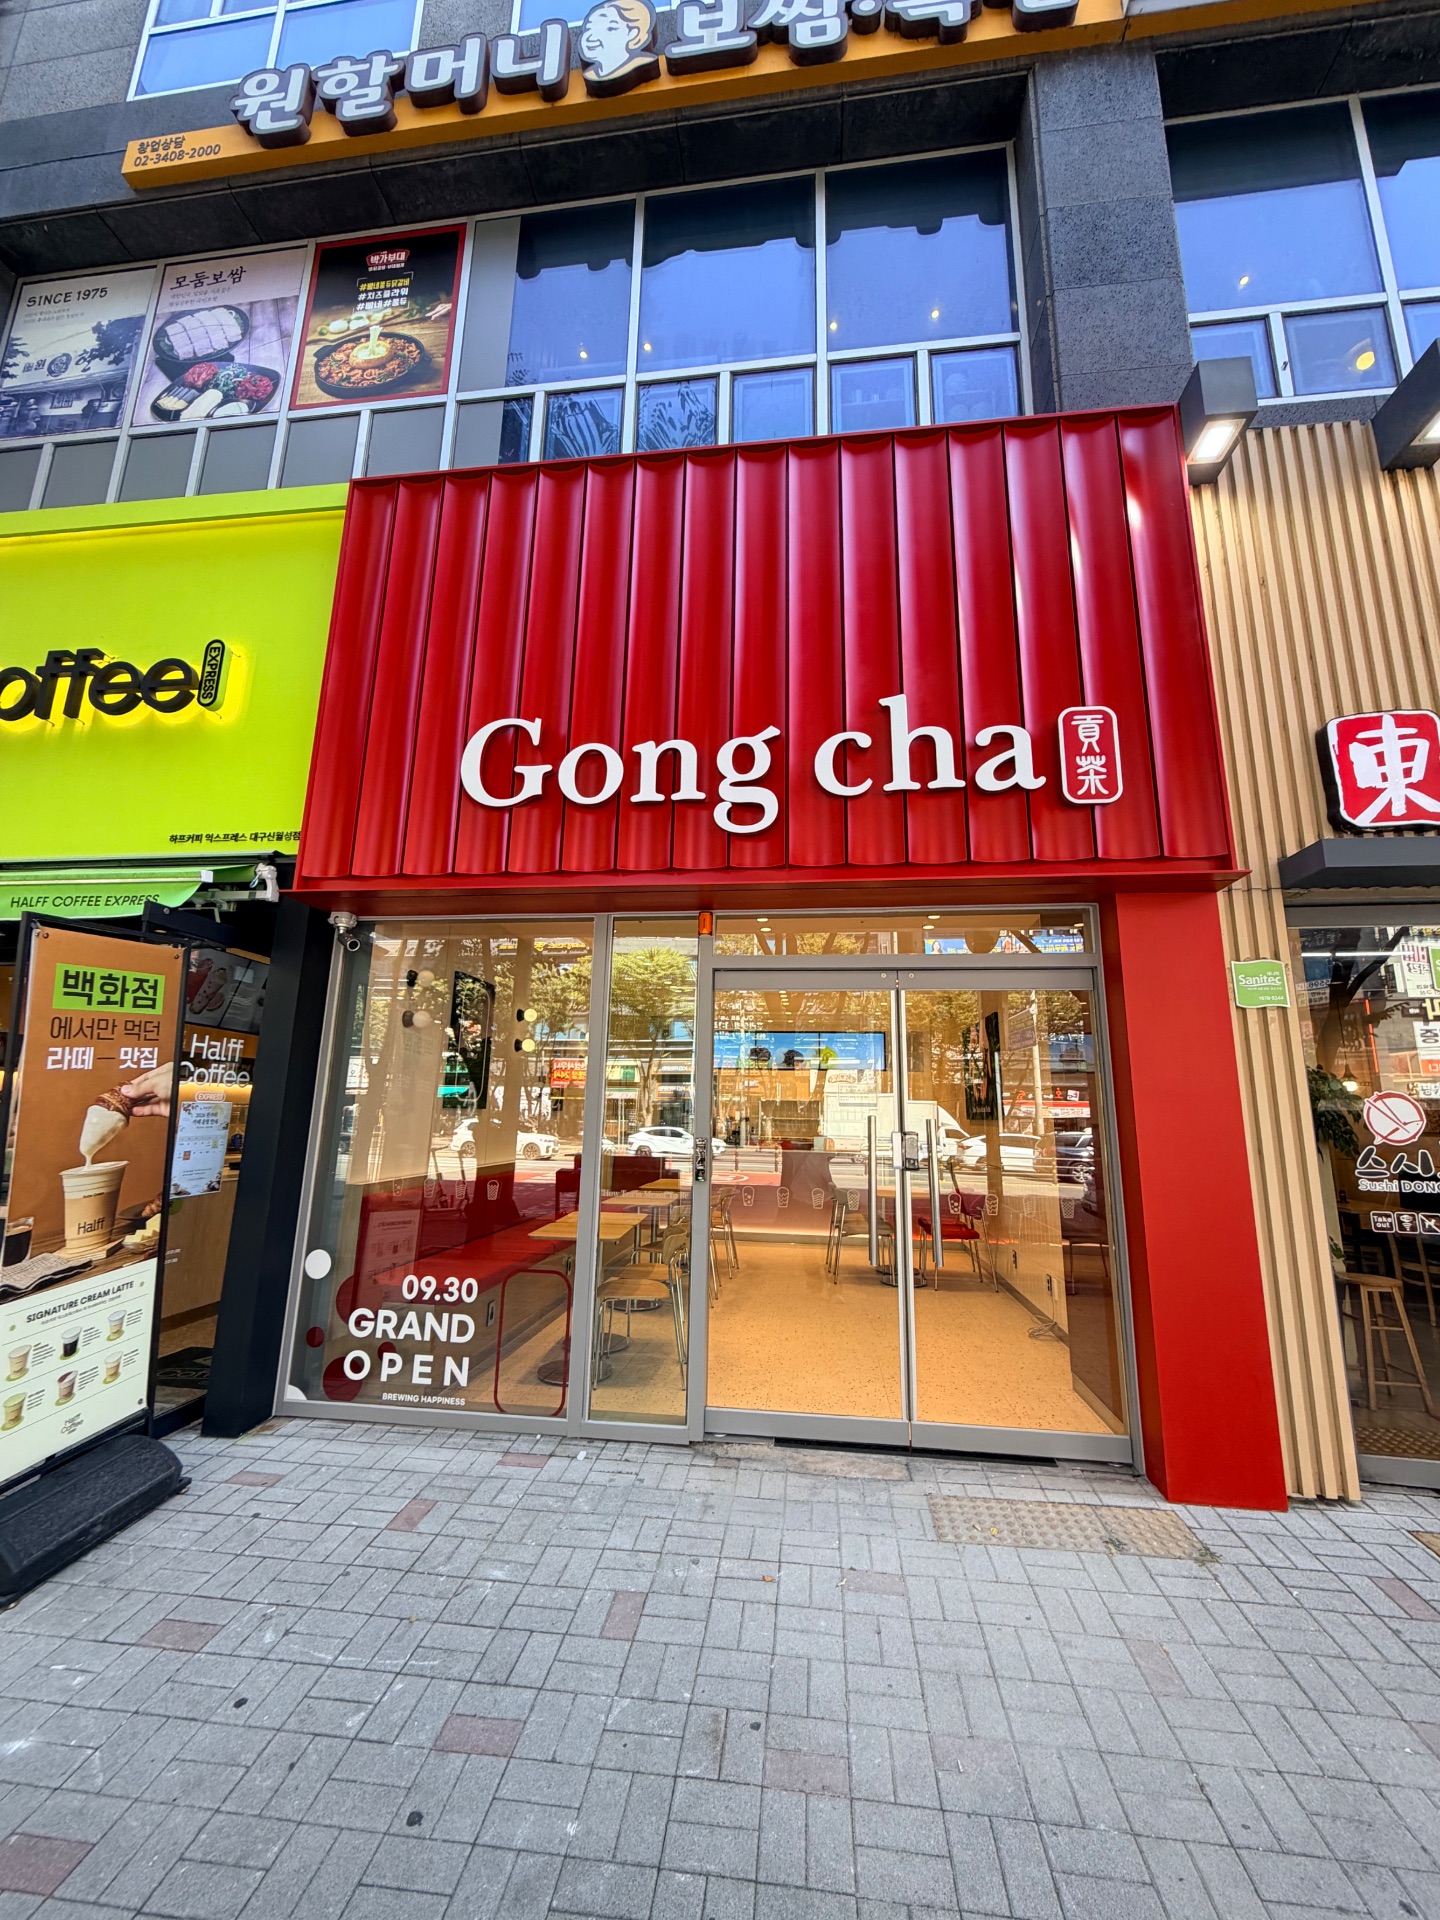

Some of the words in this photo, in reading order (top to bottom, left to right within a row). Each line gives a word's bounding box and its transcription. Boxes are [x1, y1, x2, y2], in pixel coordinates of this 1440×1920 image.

[232, 20, 568, 140] 원할머니
[134, 144, 221, 167] 02-3408-2000
[137, 135, 186, 154] 창업상담
[370, 251, 406, 264] 박가부대
[170, 266, 247, 290] 모둠보쌈
[26, 292, 73, 308] SINCE
[76, 287, 108, 301] 1975
[358, 287, 409, 301] #치즈플라워
[201, 646, 222, 700] EXPRESS
[461, 717, 781, 833] Gong
[814, 693, 1047, 797] cha
[169, 834, 203, 844] 하프커피
[205, 833, 248, 843] 익스프레스
[10, 896, 49, 908] HALFF
[52, 895, 102, 907] COFFEE
[62, 970, 159, 1010] 백화점
[1238, 974, 1283, 985] Sanitec
[50, 1016, 118, 1040] 에서만
[124, 1020, 160, 1041] 먹던
[46, 1046, 95, 1070] 라떼
[119, 1047, 159, 1069] 맛집
[189, 1033, 244, 1062] Halff
[180, 1061, 250, 1088] Coffee
[1355, 1144, 1440, 1178] 스시
[1358, 1179, 1399, 1192] Sushi
[77, 1217, 105, 1235] Halff
[1373, 1215, 1392, 1223] Take
[402, 1274, 478, 1303] 09.30
[26, 1300, 79, 1323] SIGNATURE
[80, 1288, 110, 1304] CREAM
[112, 1281, 134, 1294] LATTE
[348, 1308, 475, 1344] GRAND
[343, 1350, 470, 1387] OPEN
[382, 1392, 419, 1403] BREWING
[421, 1396, 465, 1406] HAPPINESS
